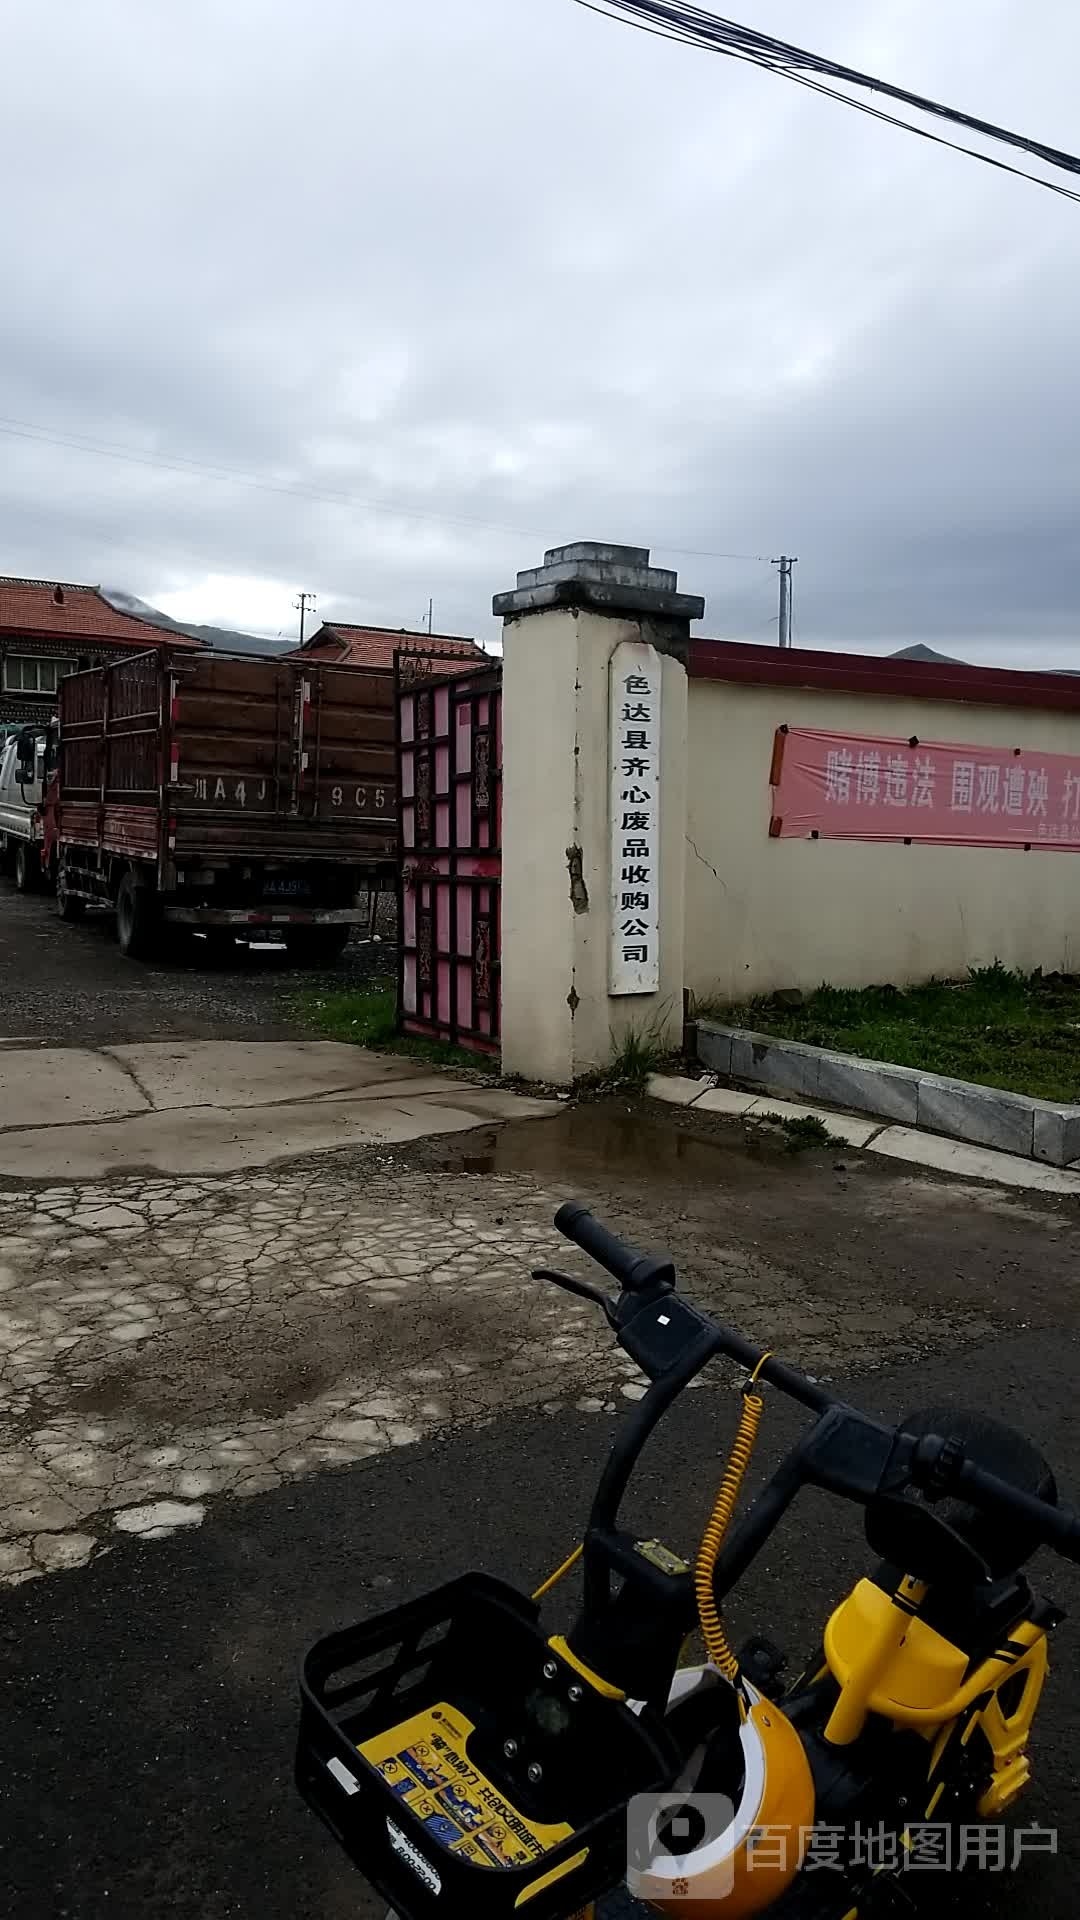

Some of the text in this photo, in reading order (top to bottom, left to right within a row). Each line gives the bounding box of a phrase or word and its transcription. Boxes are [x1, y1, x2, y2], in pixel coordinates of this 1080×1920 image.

[620, 673, 652, 963] 色达县齐心废品收购公司
[825, 748, 937, 809] 赌博违法
[951, 759, 1049, 817] 围观遭殃
